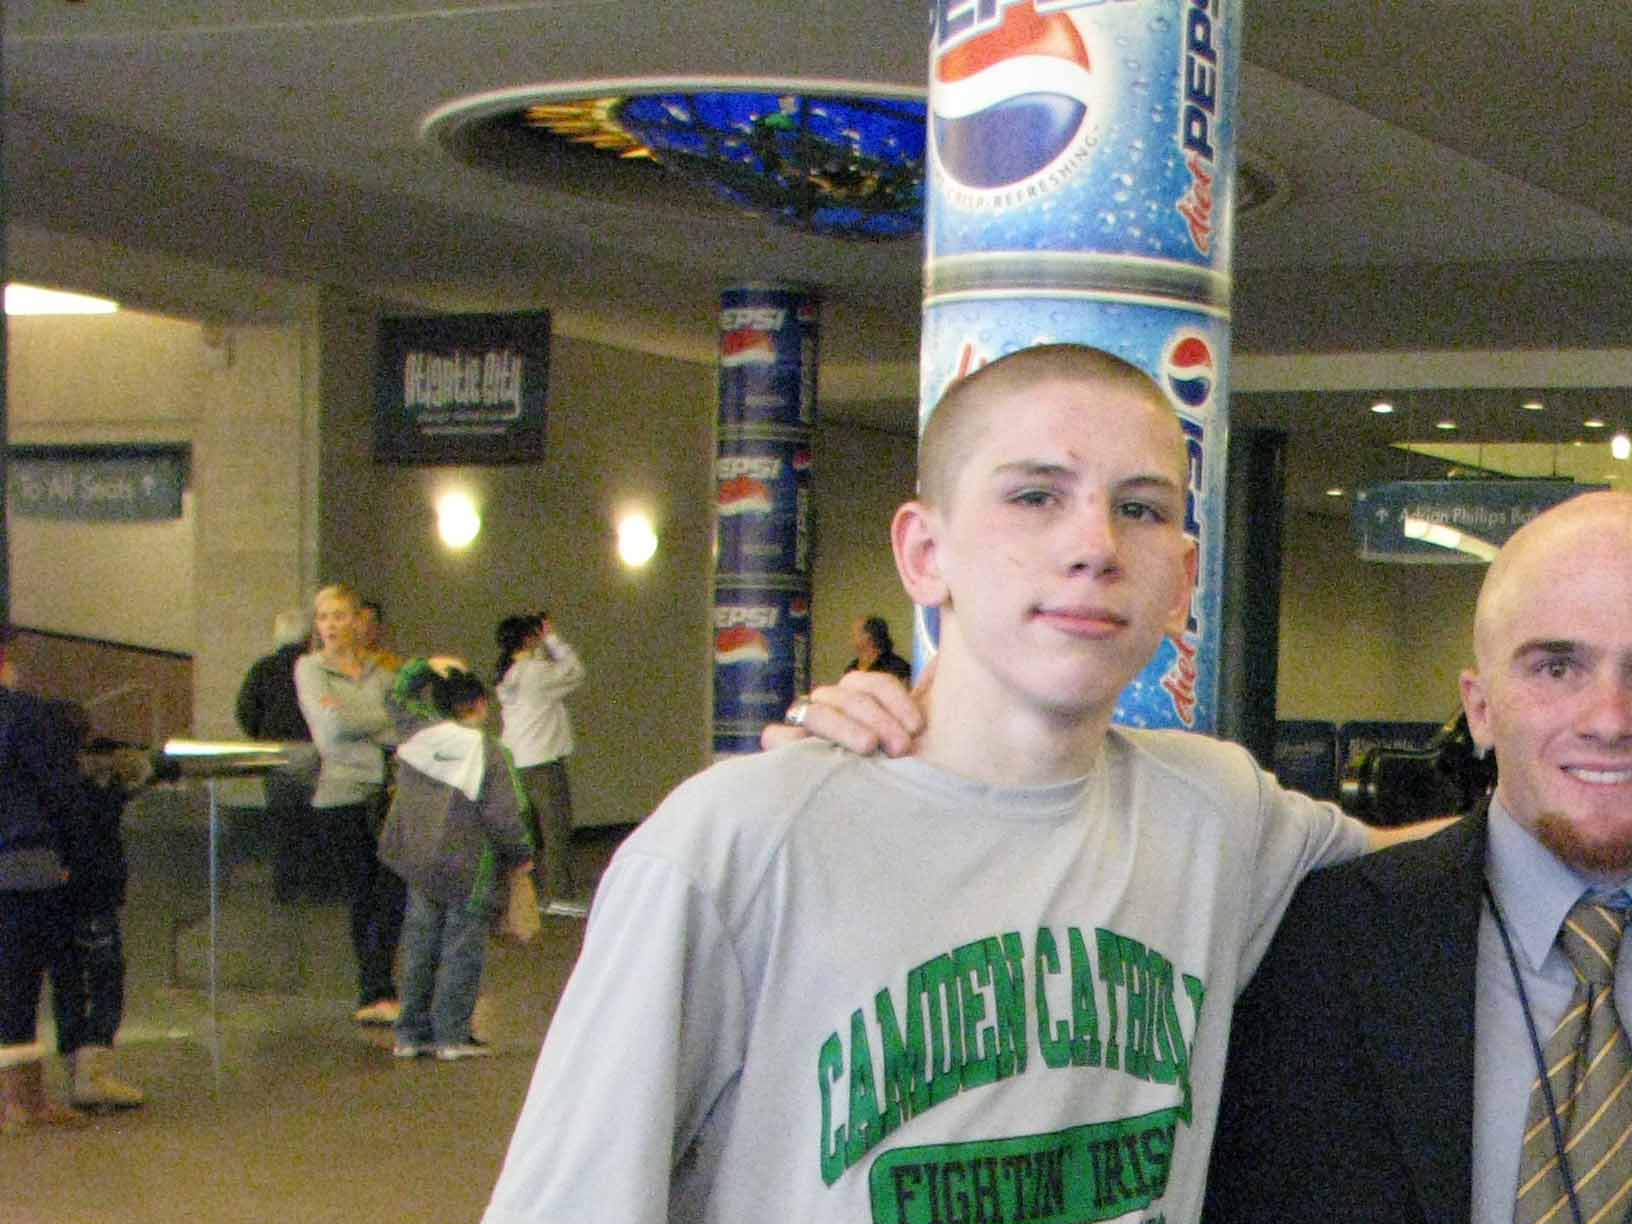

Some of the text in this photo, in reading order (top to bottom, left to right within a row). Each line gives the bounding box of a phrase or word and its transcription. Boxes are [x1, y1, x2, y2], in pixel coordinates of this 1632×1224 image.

[993, 136, 1100, 206] REFRESHING
[720, 307, 788, 331] EPSI
[718, 456, 783, 481] EPSI
[716, 604, 781, 630] EPSI
[818, 931, 1027, 1189] CAMDEN
